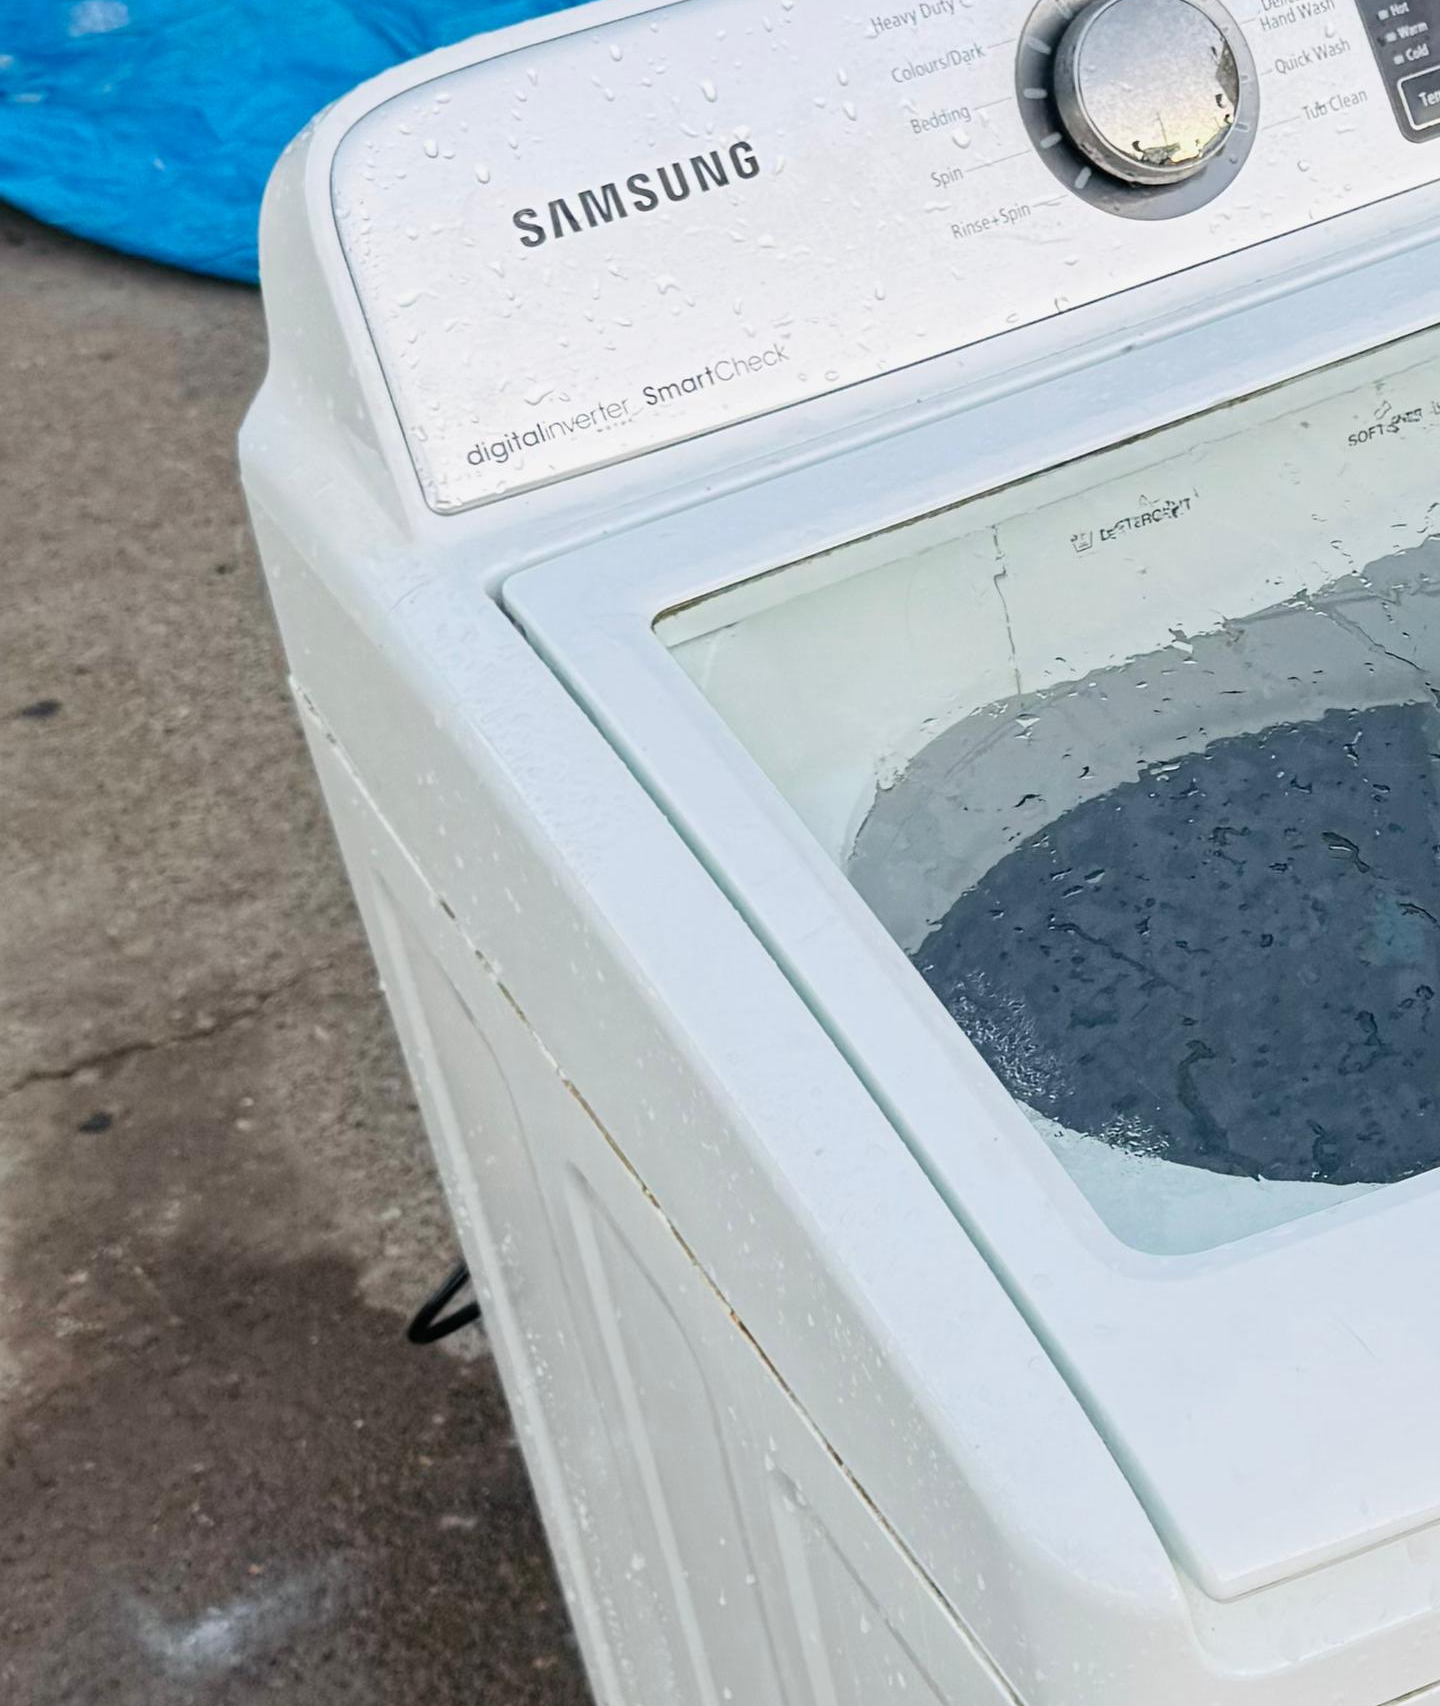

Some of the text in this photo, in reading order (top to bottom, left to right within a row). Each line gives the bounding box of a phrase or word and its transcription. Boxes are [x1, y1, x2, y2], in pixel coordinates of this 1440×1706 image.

[871, 10, 921, 35] Heavy
[1260, 7, 1297, 31] Hand
[1390, 2, 1410, 16] Hot
[1397, 22, 1429, 39] Warm
[891, 43, 986, 84] Colours/Dark
[1275, 38, 1351, 74] Quick Wash
[1405, 43, 1430, 61] Cold
[1302, 91, 1368, 121] Tub Clean
[910, 107, 972, 134] Bedding
[930, 166, 964, 189] Spin
[512, 141, 760, 248] SAMSUNG
[951, 203, 1032, 239] Rinse+Spin
[642, 343, 790, 406] SmartCheck
[1348, 407, 1422, 447] SOFT
